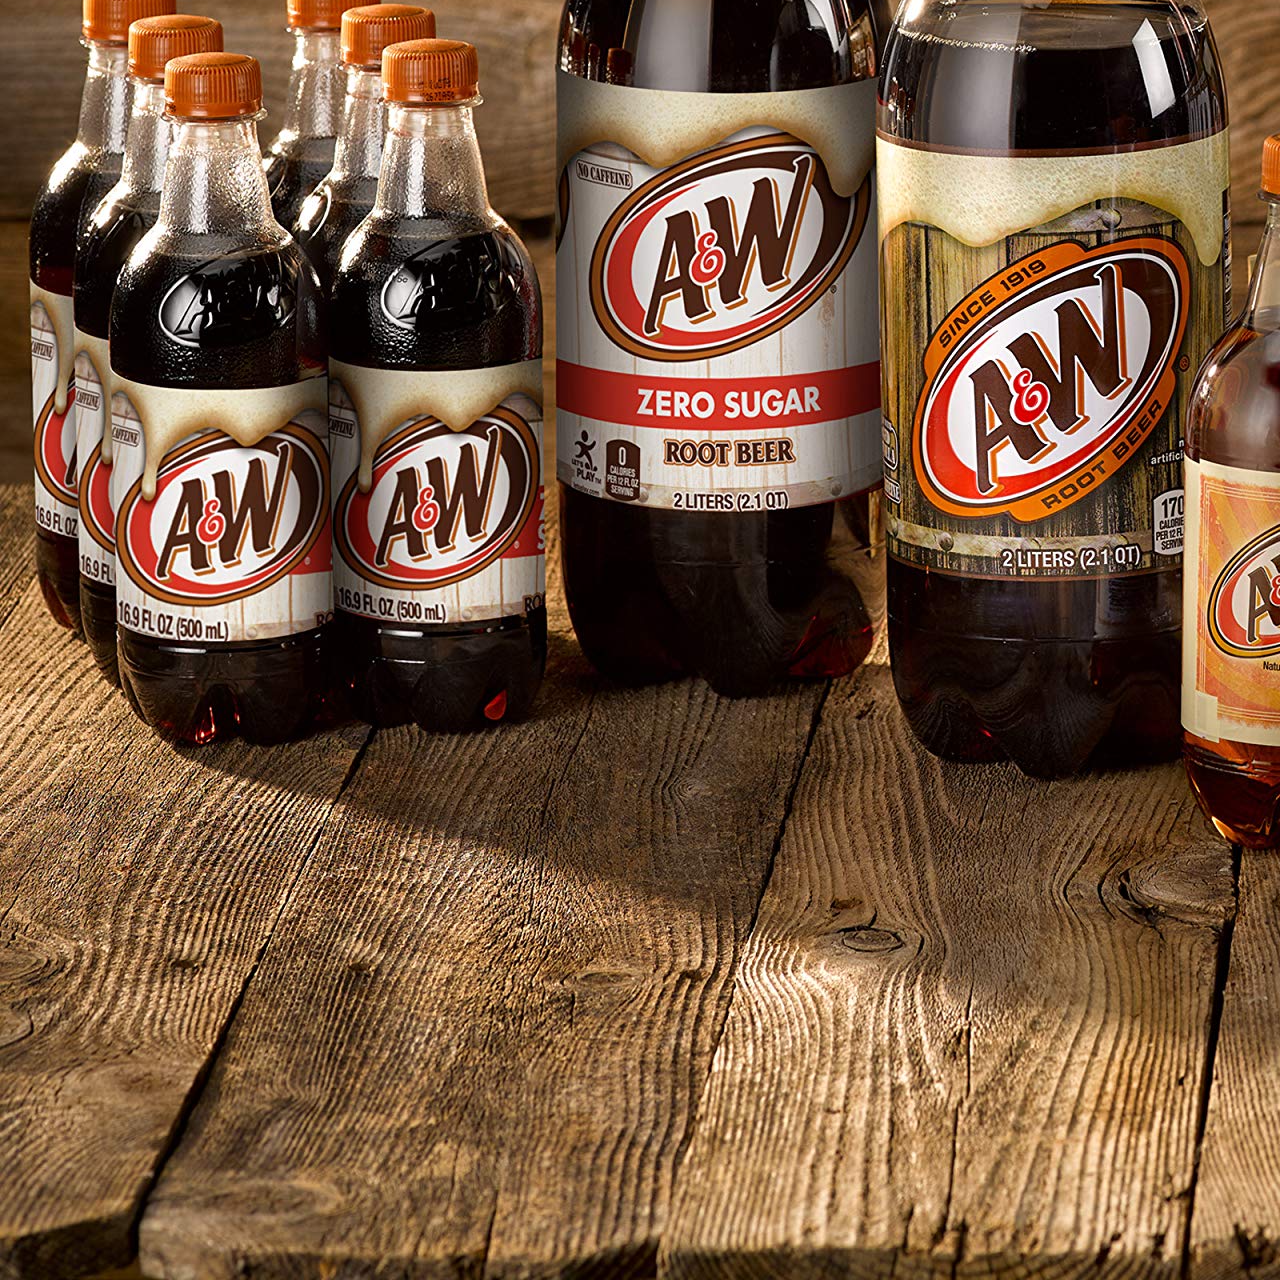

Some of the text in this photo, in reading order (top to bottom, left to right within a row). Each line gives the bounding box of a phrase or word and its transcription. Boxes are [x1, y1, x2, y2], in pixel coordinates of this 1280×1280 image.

[577, 162, 631, 187] NO CAFFEINE
[643, 153, 816, 340] A&W
[938, 259, 1048, 349] SINCE 1919
[970, 263, 1133, 497] A&W
[76, 390, 99, 408] CAFFEINE
[636, 385, 822, 419] ZERO SUGAR
[112, 426, 138, 444] CAFFEINE
[329, 417, 354, 436] AFFEINE
[618, 446, 627, 466] 0
[664, 436, 798, 467] ROOT BEER
[1040, 398, 1164, 510] ROOT BEER
[1150, 451, 1185, 465] artifici
[606, 474, 639, 488] PER 12 FL OZ
[609, 465, 636, 478] CALORIES
[375, 425, 503, 568] A&W
[610, 484, 634, 497] SERVING
[673, 491, 789, 512] 2 LITERS (2.1 QT)
[35, 504, 78, 536] 16.9 FL OZ
[156, 441, 294, 582] A&W
[1161, 496, 1184, 519] 170
[1156, 530, 1169, 541] PER
[1169, 530, 1176, 540] 12
[1159, 519, 1184, 530] CALORIE
[1161, 538, 1184, 551] SERVIN
[81, 554, 112, 584] 16.9 FL
[1002, 545, 1141, 570] 2 LITERS (2.1 QT)
[338, 586, 447, 623] 16.9 FL OZ (500 mL)
[118, 600, 229, 642] 16.9 FL OZ (500 mL)
